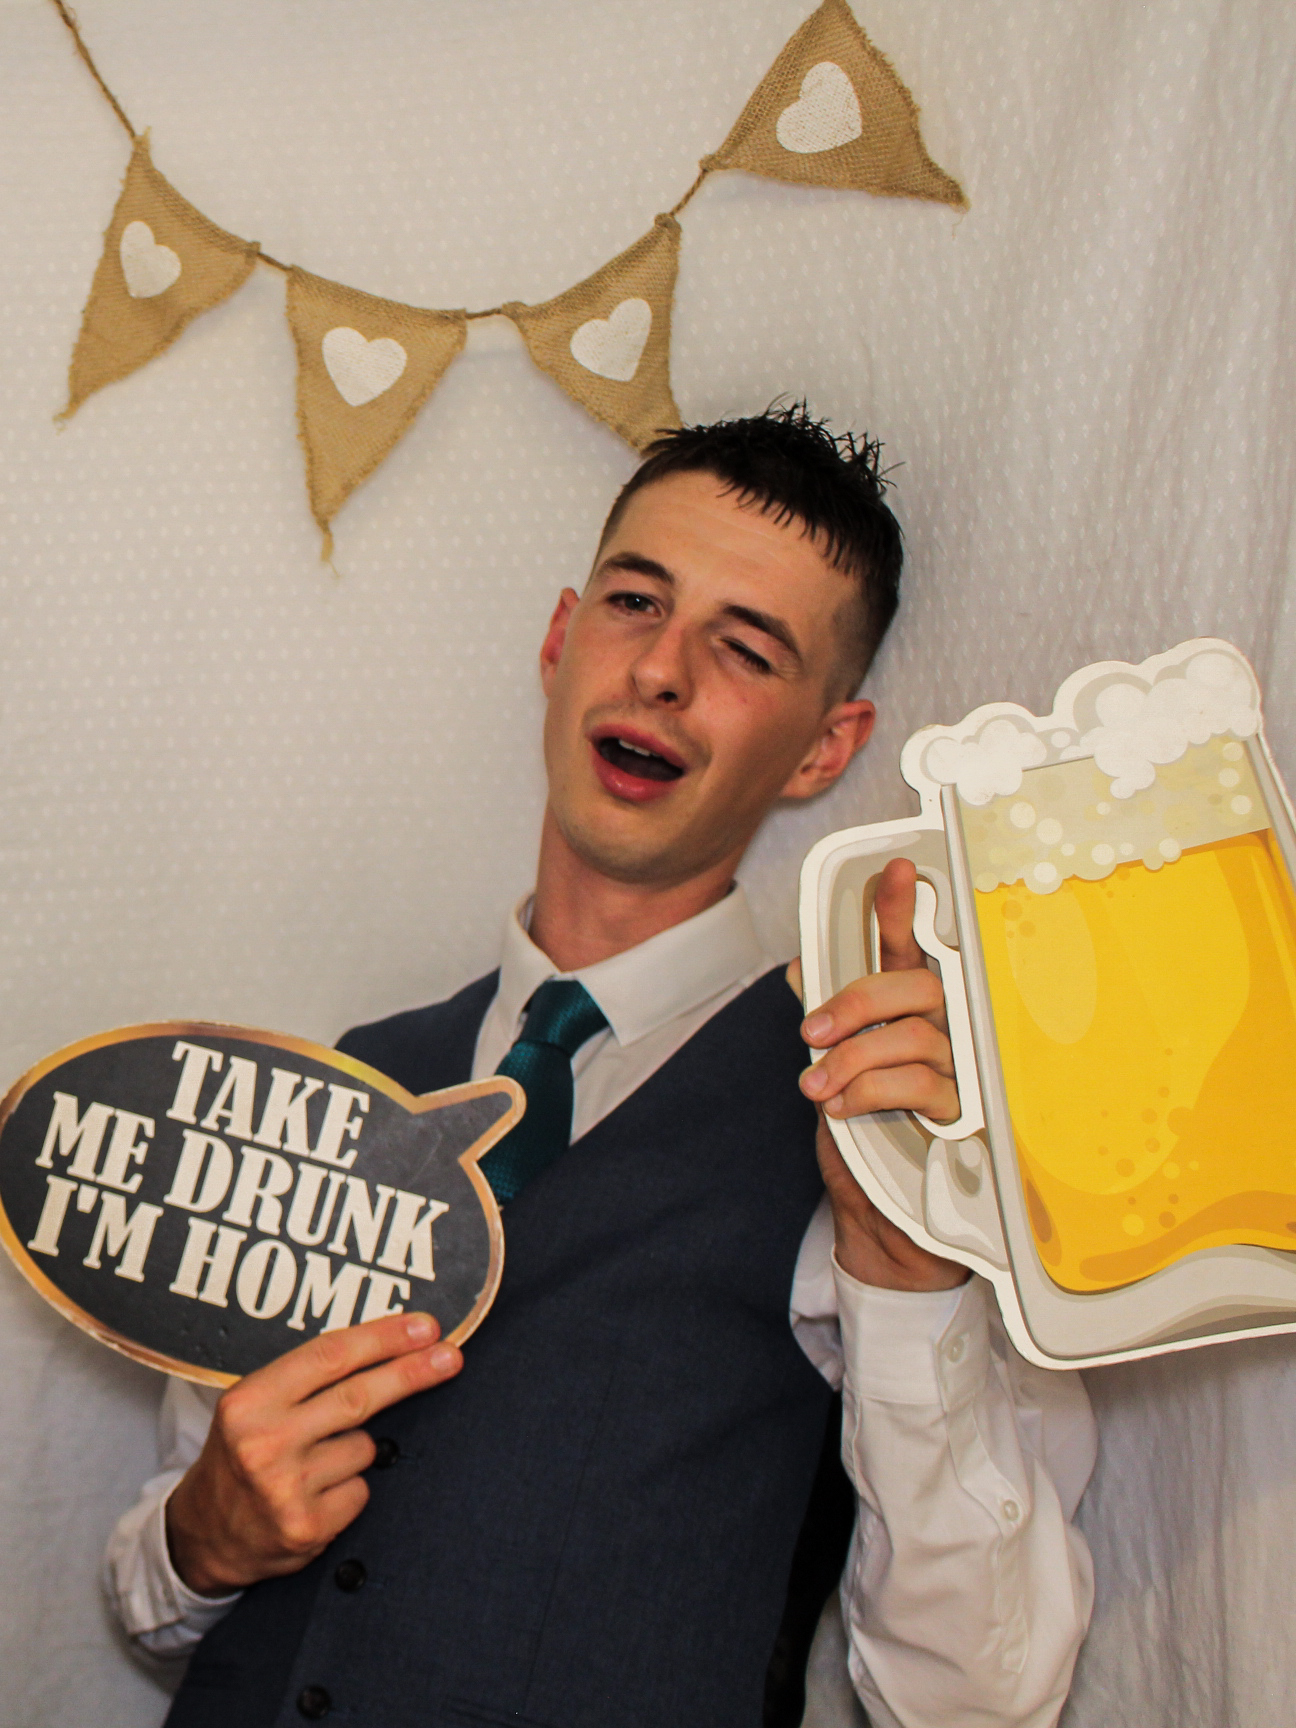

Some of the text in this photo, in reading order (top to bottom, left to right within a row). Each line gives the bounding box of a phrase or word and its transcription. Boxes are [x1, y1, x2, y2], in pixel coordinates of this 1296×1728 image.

[166, 1040, 371, 1169] TAKE
[27, 1174, 163, 1283] I'M
[35, 1091, 449, 1281] ME DRUNK
